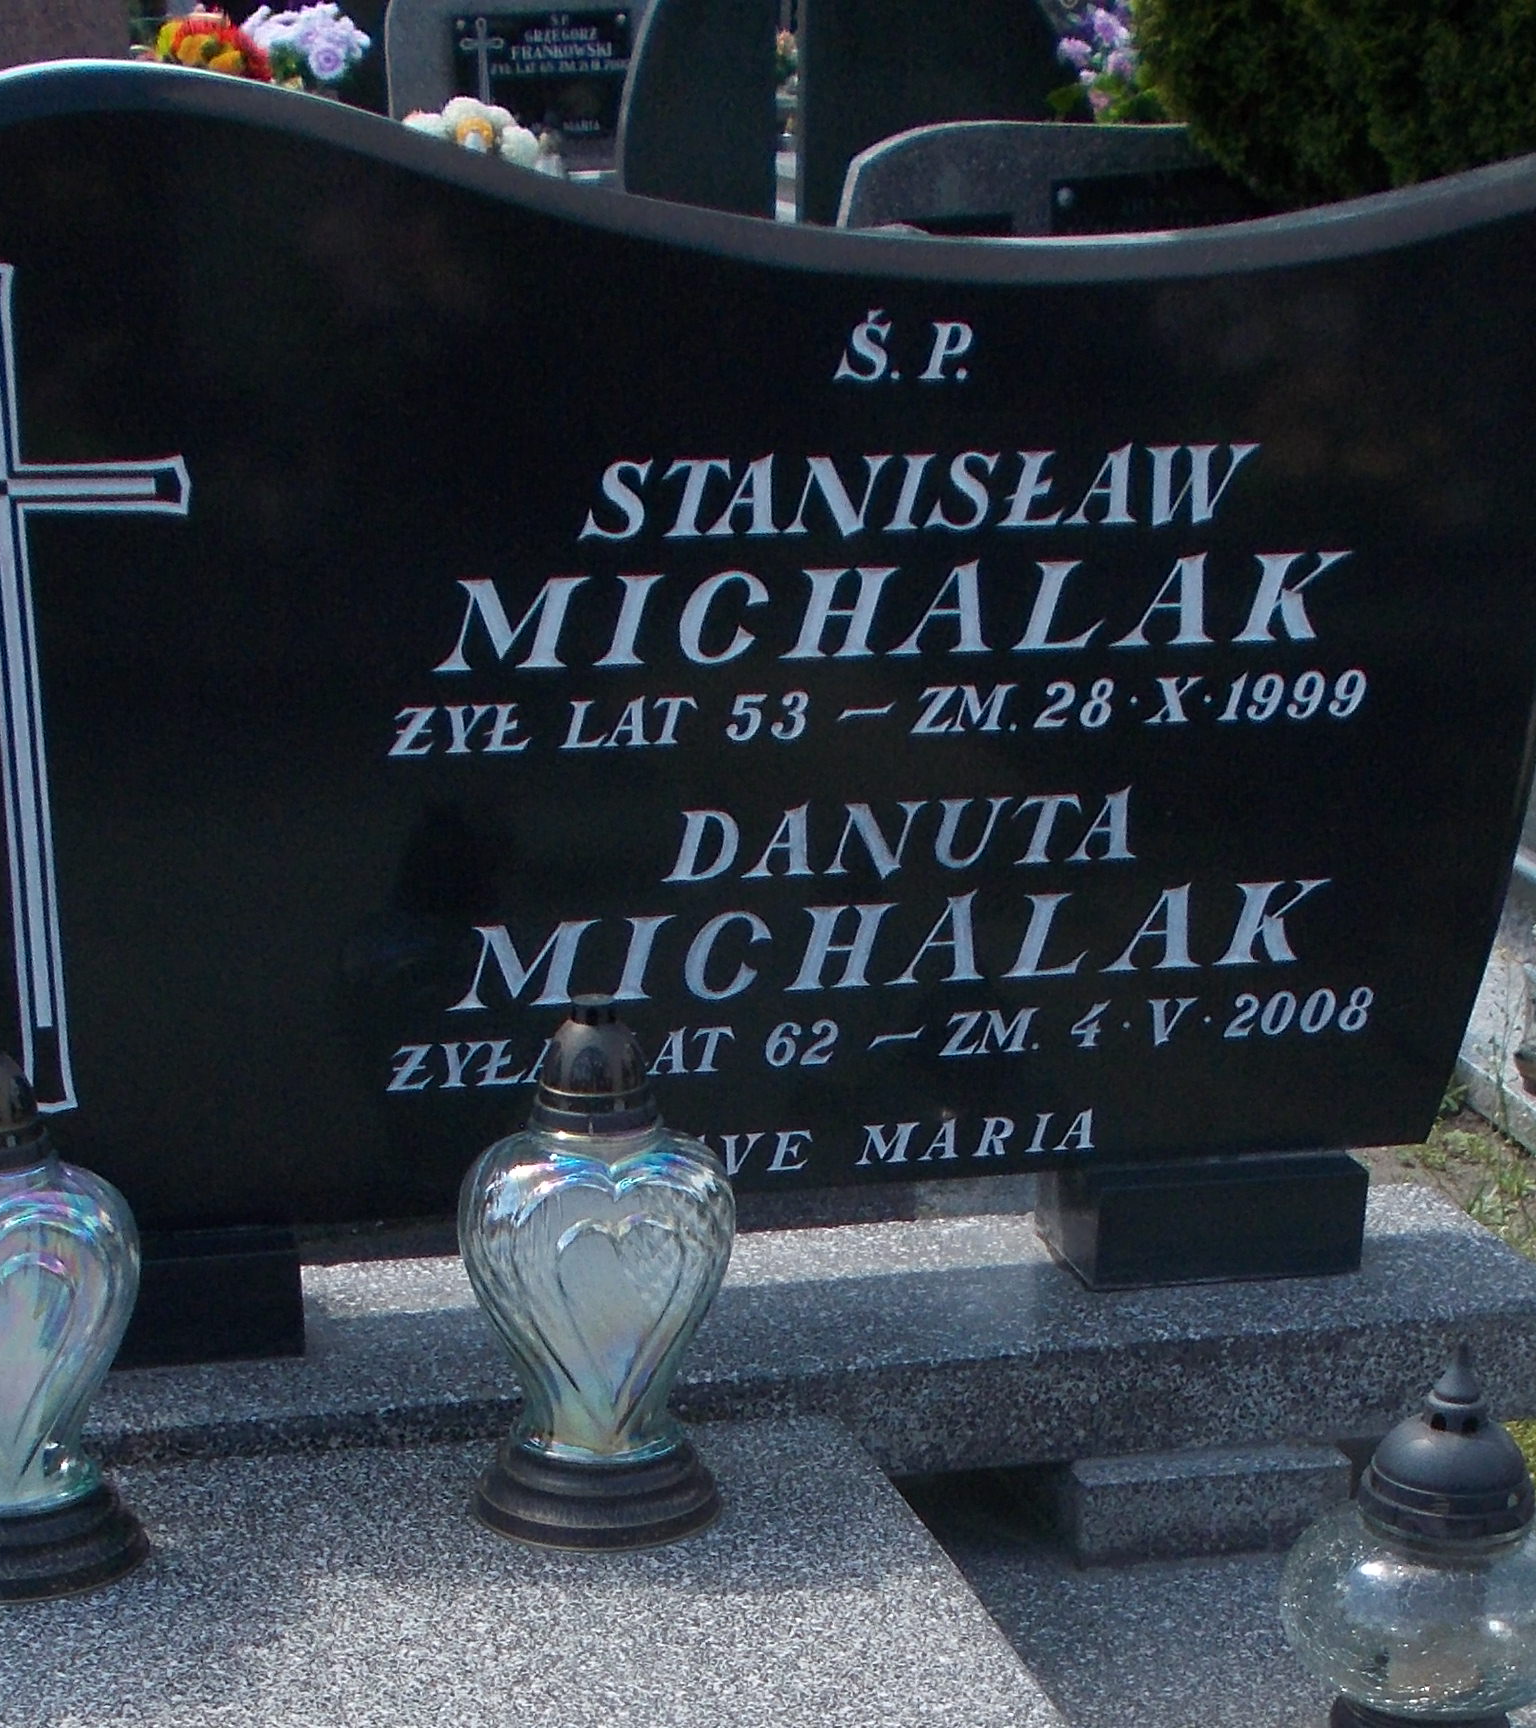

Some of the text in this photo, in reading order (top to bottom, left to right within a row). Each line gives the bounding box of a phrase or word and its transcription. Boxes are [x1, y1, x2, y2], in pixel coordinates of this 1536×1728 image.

[511, 42, 613, 61] FRANKOWSKI
[523, 27, 598, 45] GRZEGORZ
[578, 442, 1260, 540] STANISŁAW
[432, 550, 1352, 672] MICHALAK
[559, 695, 698, 749] LAT
[725, 690, 809, 742] 53
[660, 785, 1137, 883] DANUTA
[445, 878, 1331, 1013] MICHALAK
[765, 1019, 839, 1067] 62
[696, 1108, 1096, 1178] VE MARIA
